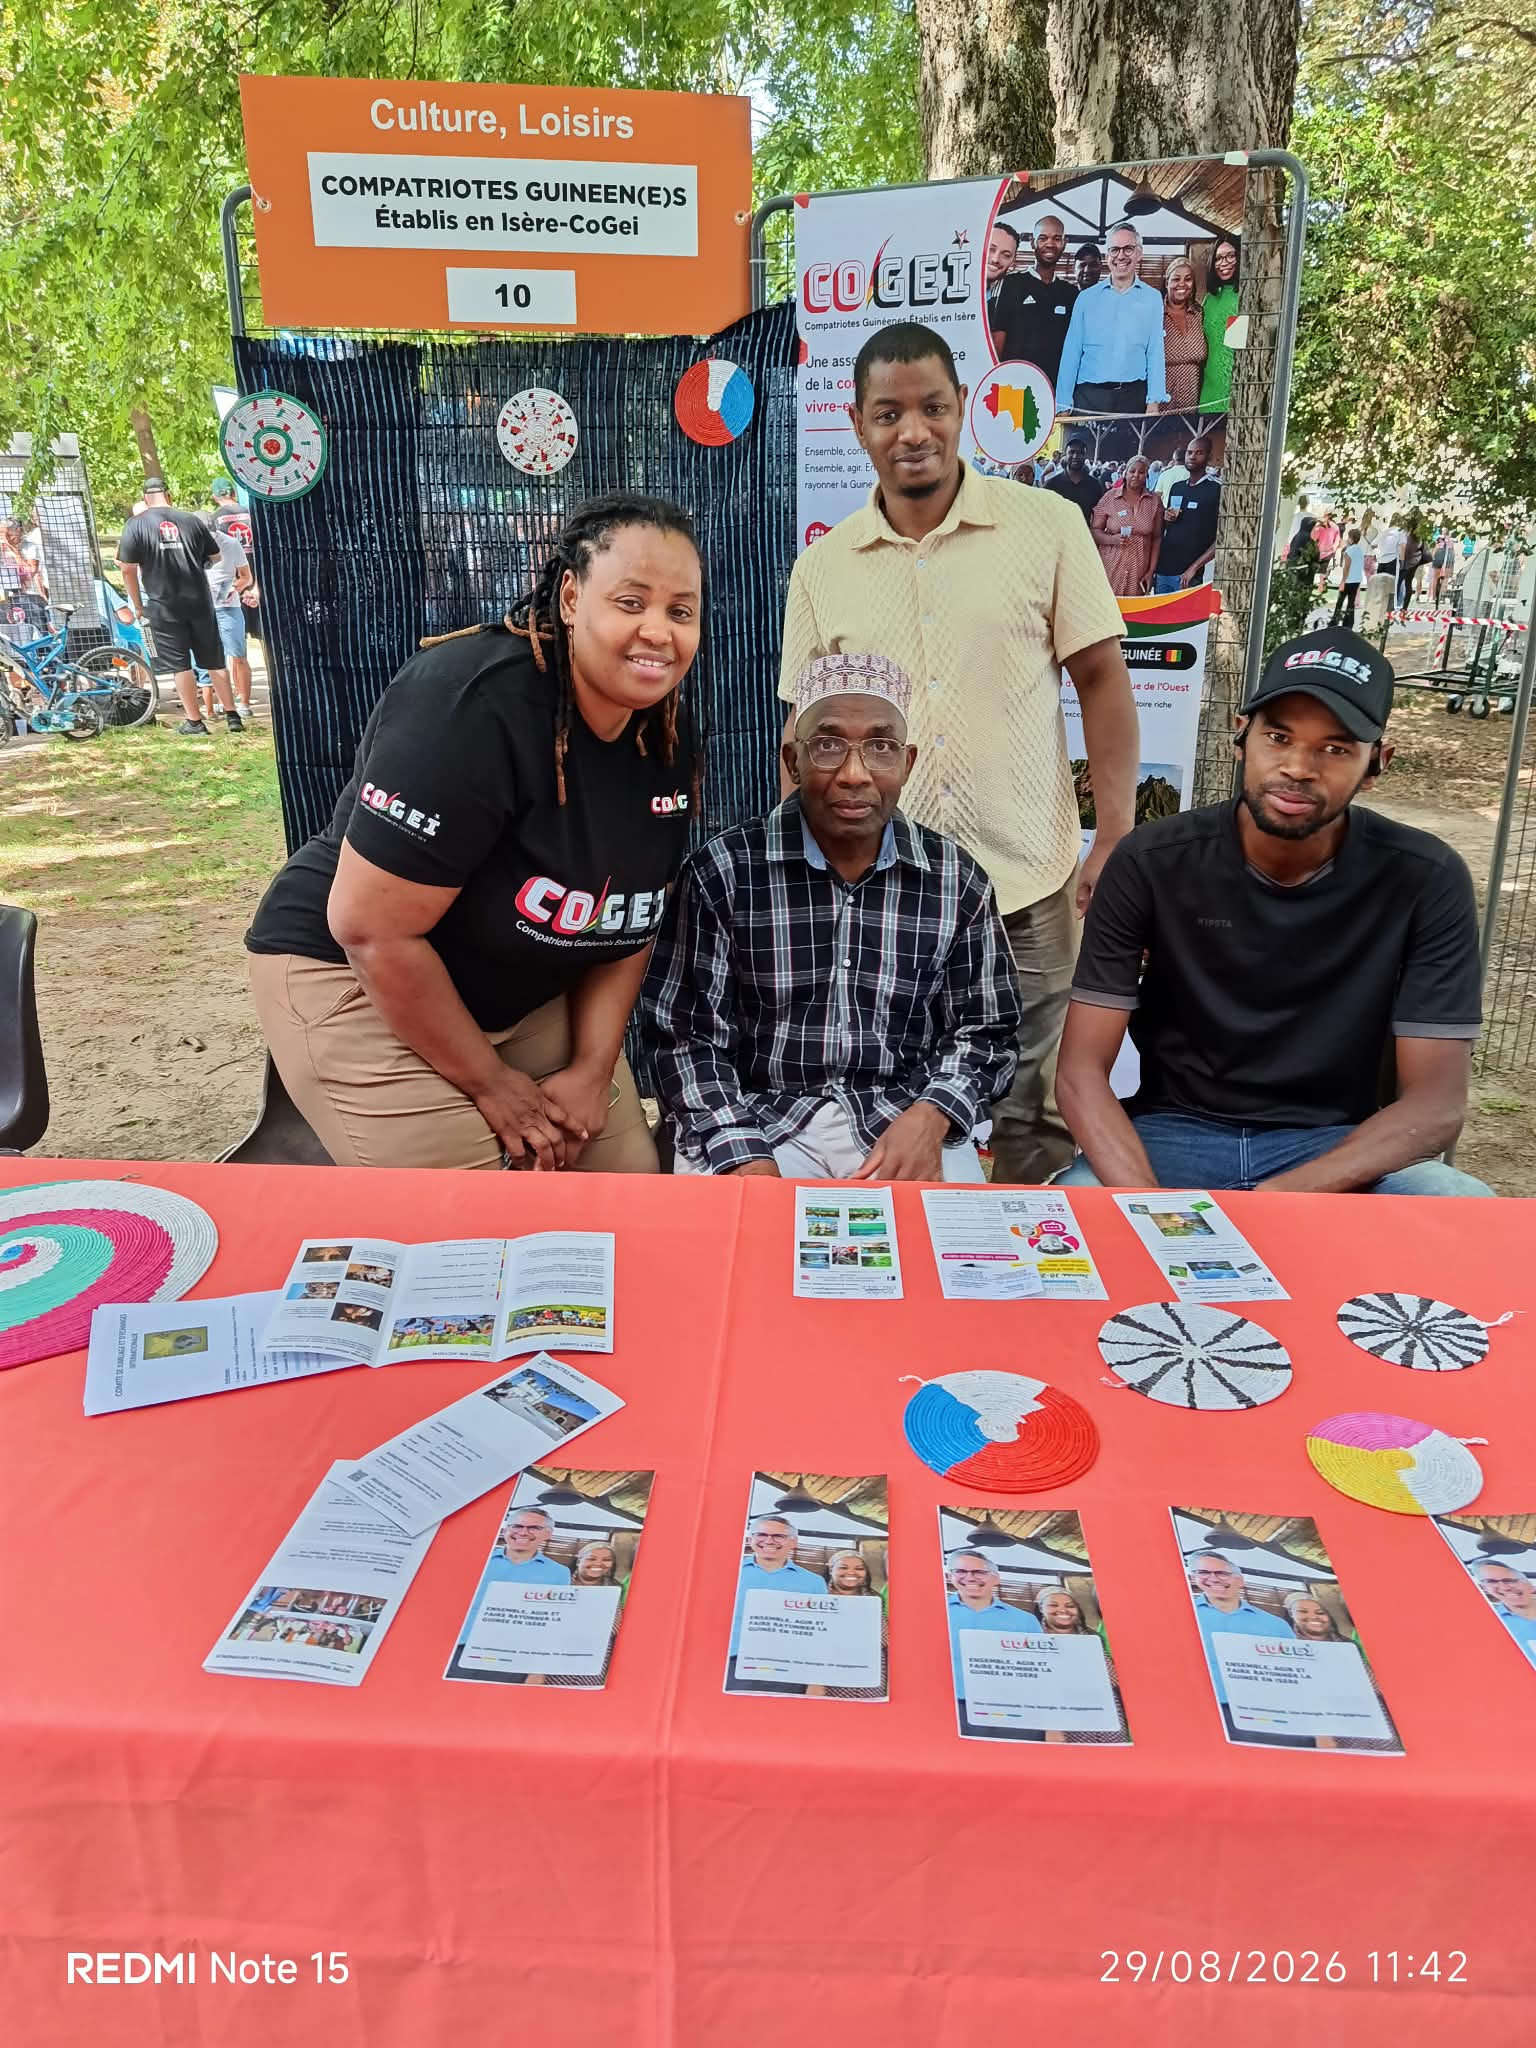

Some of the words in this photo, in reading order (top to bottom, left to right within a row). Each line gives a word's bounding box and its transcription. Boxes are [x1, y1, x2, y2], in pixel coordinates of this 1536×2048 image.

[370, 98, 507, 140] Culture,
[518, 103, 635, 140] Loisirs
[321, 175, 518, 201] COMPATRIOTES
[525, 181, 687, 207] GUINEEN(E)S
[375, 204, 459, 232] Établis
[465, 213, 494, 232] en
[501, 211, 640, 236] Isère-CoGei
[803, 250, 972, 314] COGEI
[494, 284, 531, 309] 10
[804, 321, 860, 332] Compatriotes
[954, 312, 976, 321] Isère
[832, 357, 857, 367] asso
[952, 350, 966, 361] ce
[805, 377, 819, 390] de
[823, 376, 833, 390] la
[805, 399, 856, 413] vivre-e
[804, 447, 846, 456] Ensemble,
[804, 480, 839, 491] rayonner
[840, 480, 848, 488] la
[850, 480, 873, 489] Guiné
[1284, 650, 1373, 683] COGEI
[1144, 682, 1155, 690] de
[361, 782, 441, 837] COGEI
[651, 794, 689, 815] COG
[515, 920, 573, 947] Compatriotes
